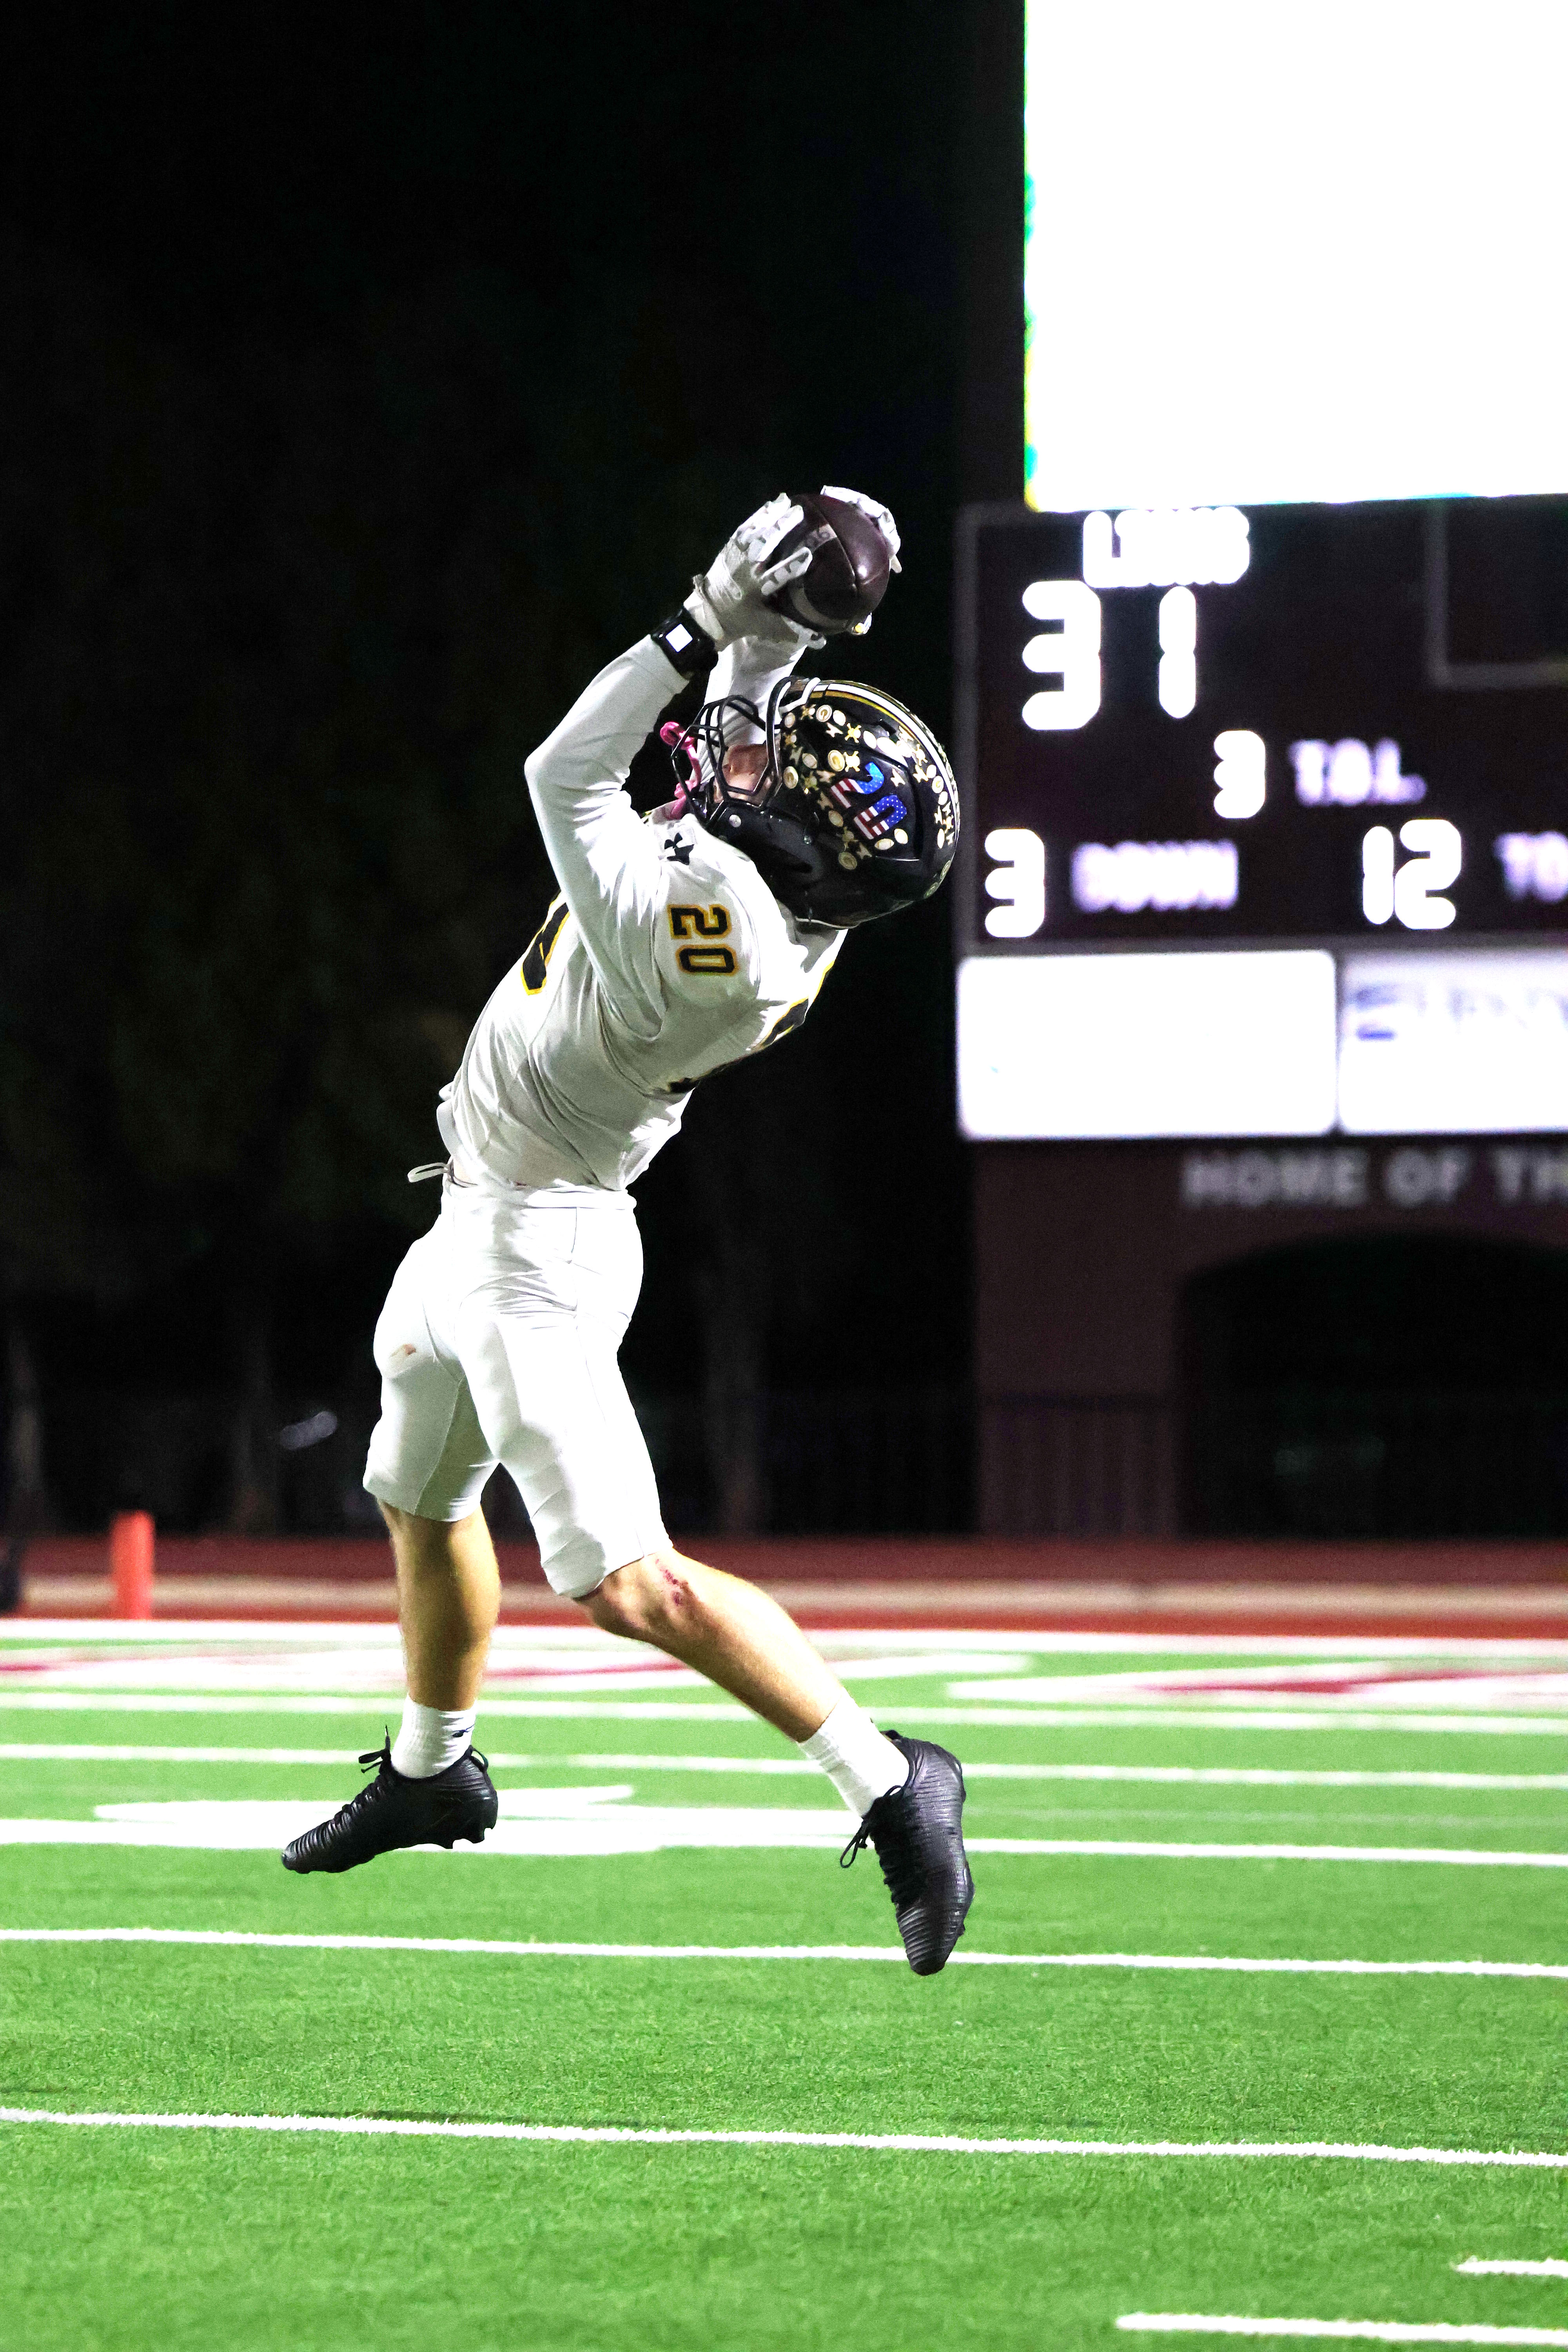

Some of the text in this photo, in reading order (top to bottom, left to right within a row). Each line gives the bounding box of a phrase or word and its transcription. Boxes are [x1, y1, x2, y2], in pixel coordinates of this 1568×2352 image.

[1022, 580, 1197, 730] 31
[830, 762, 907, 840] 20
[1213, 730, 1266, 819] 3
[984, 828, 1045, 938] 3
[1362, 818, 1462, 930] 12
[667, 904, 739, 975] 20
